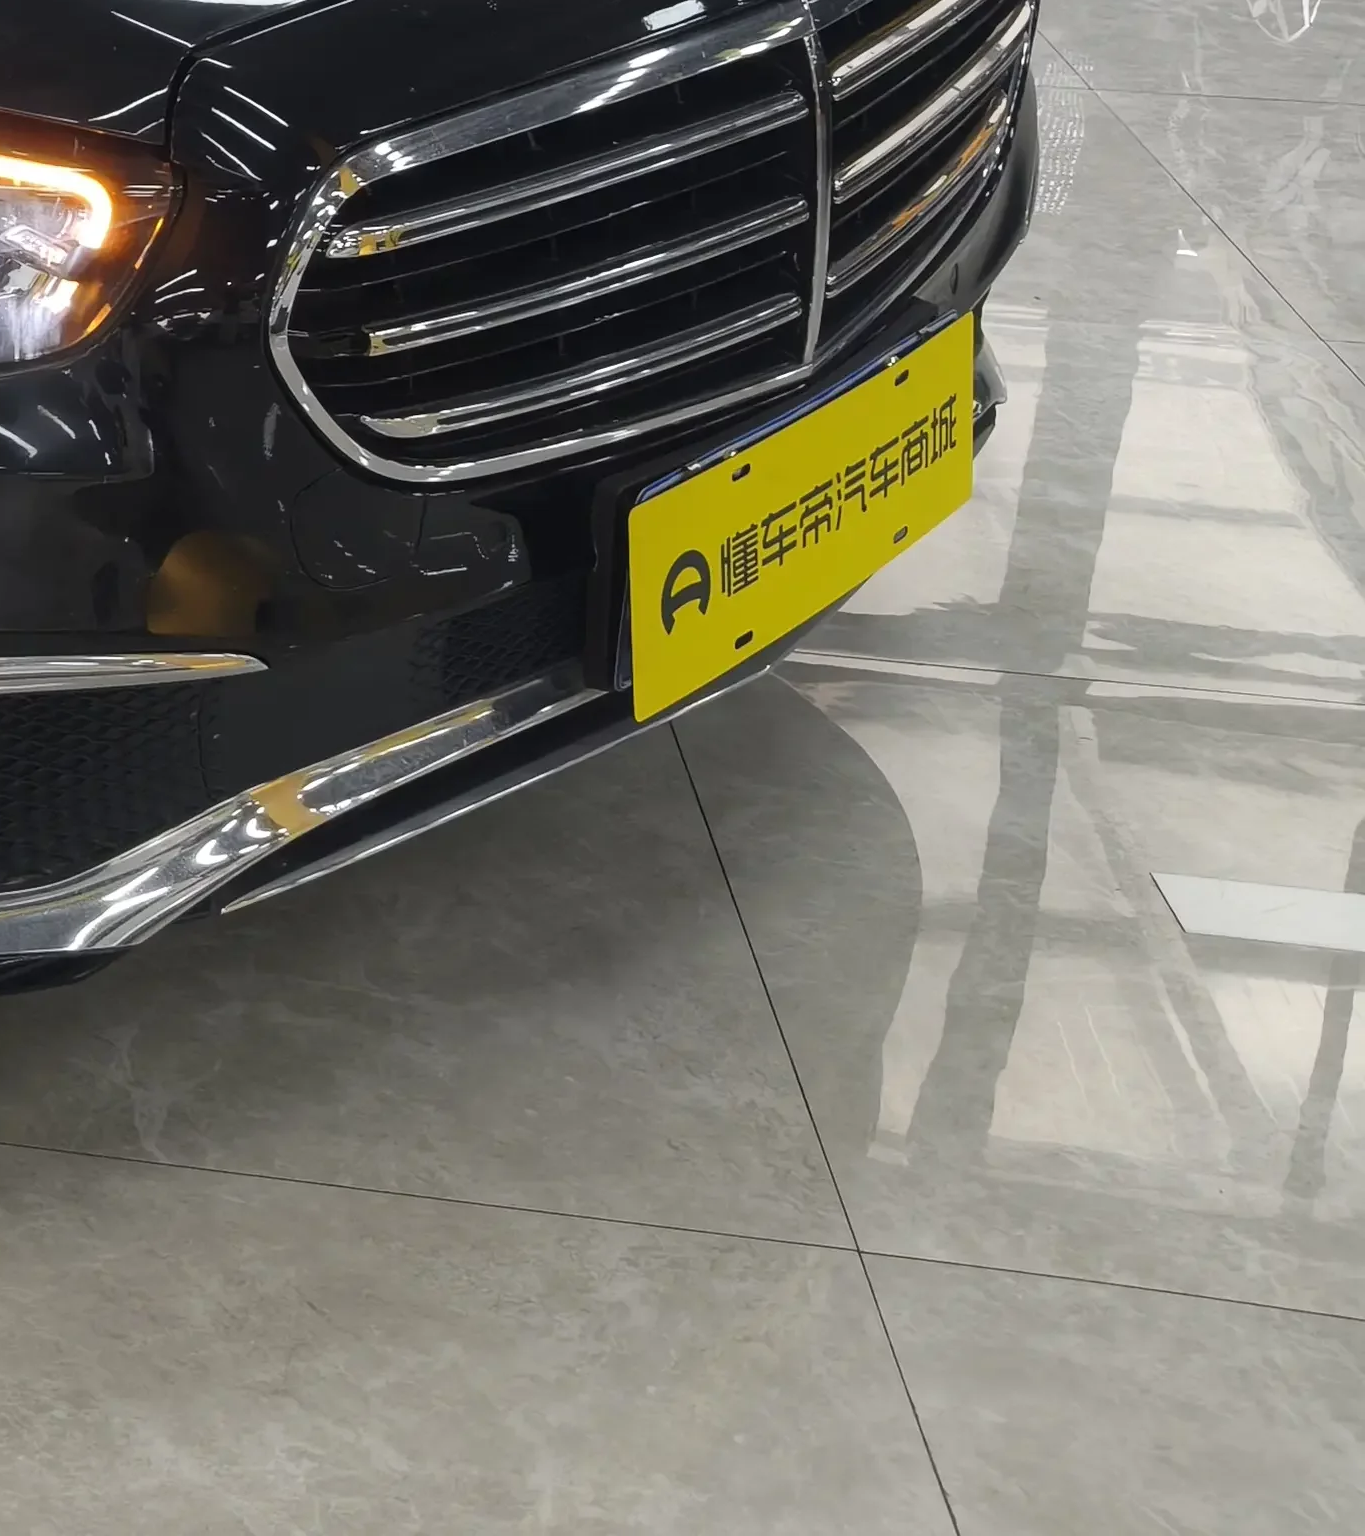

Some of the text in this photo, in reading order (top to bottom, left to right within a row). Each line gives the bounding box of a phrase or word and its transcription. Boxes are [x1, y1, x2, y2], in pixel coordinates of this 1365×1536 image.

[720, 393, 958, 598] 懂车帝汽车商城
